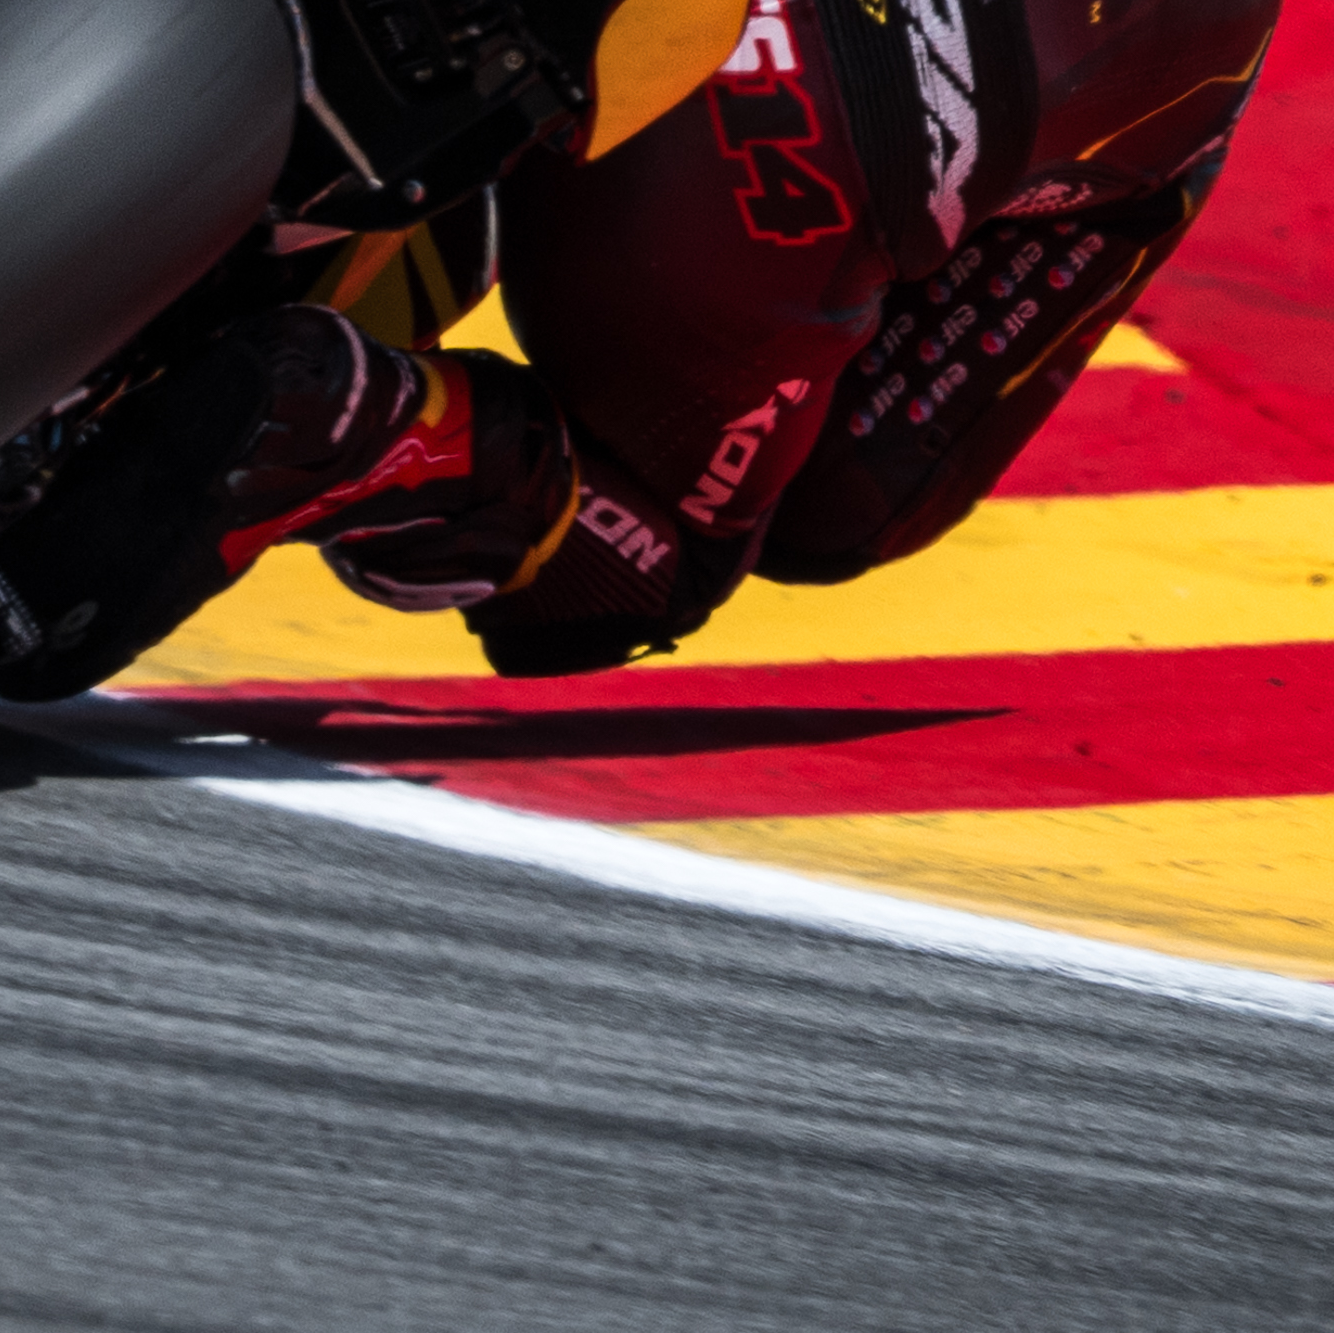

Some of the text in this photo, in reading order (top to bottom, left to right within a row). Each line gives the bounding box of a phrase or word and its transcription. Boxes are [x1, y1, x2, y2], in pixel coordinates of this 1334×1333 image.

[1009, 241, 1045, 283] elf
[940, 303, 978, 347] elf
[1002, 298, 1040, 339] elf
